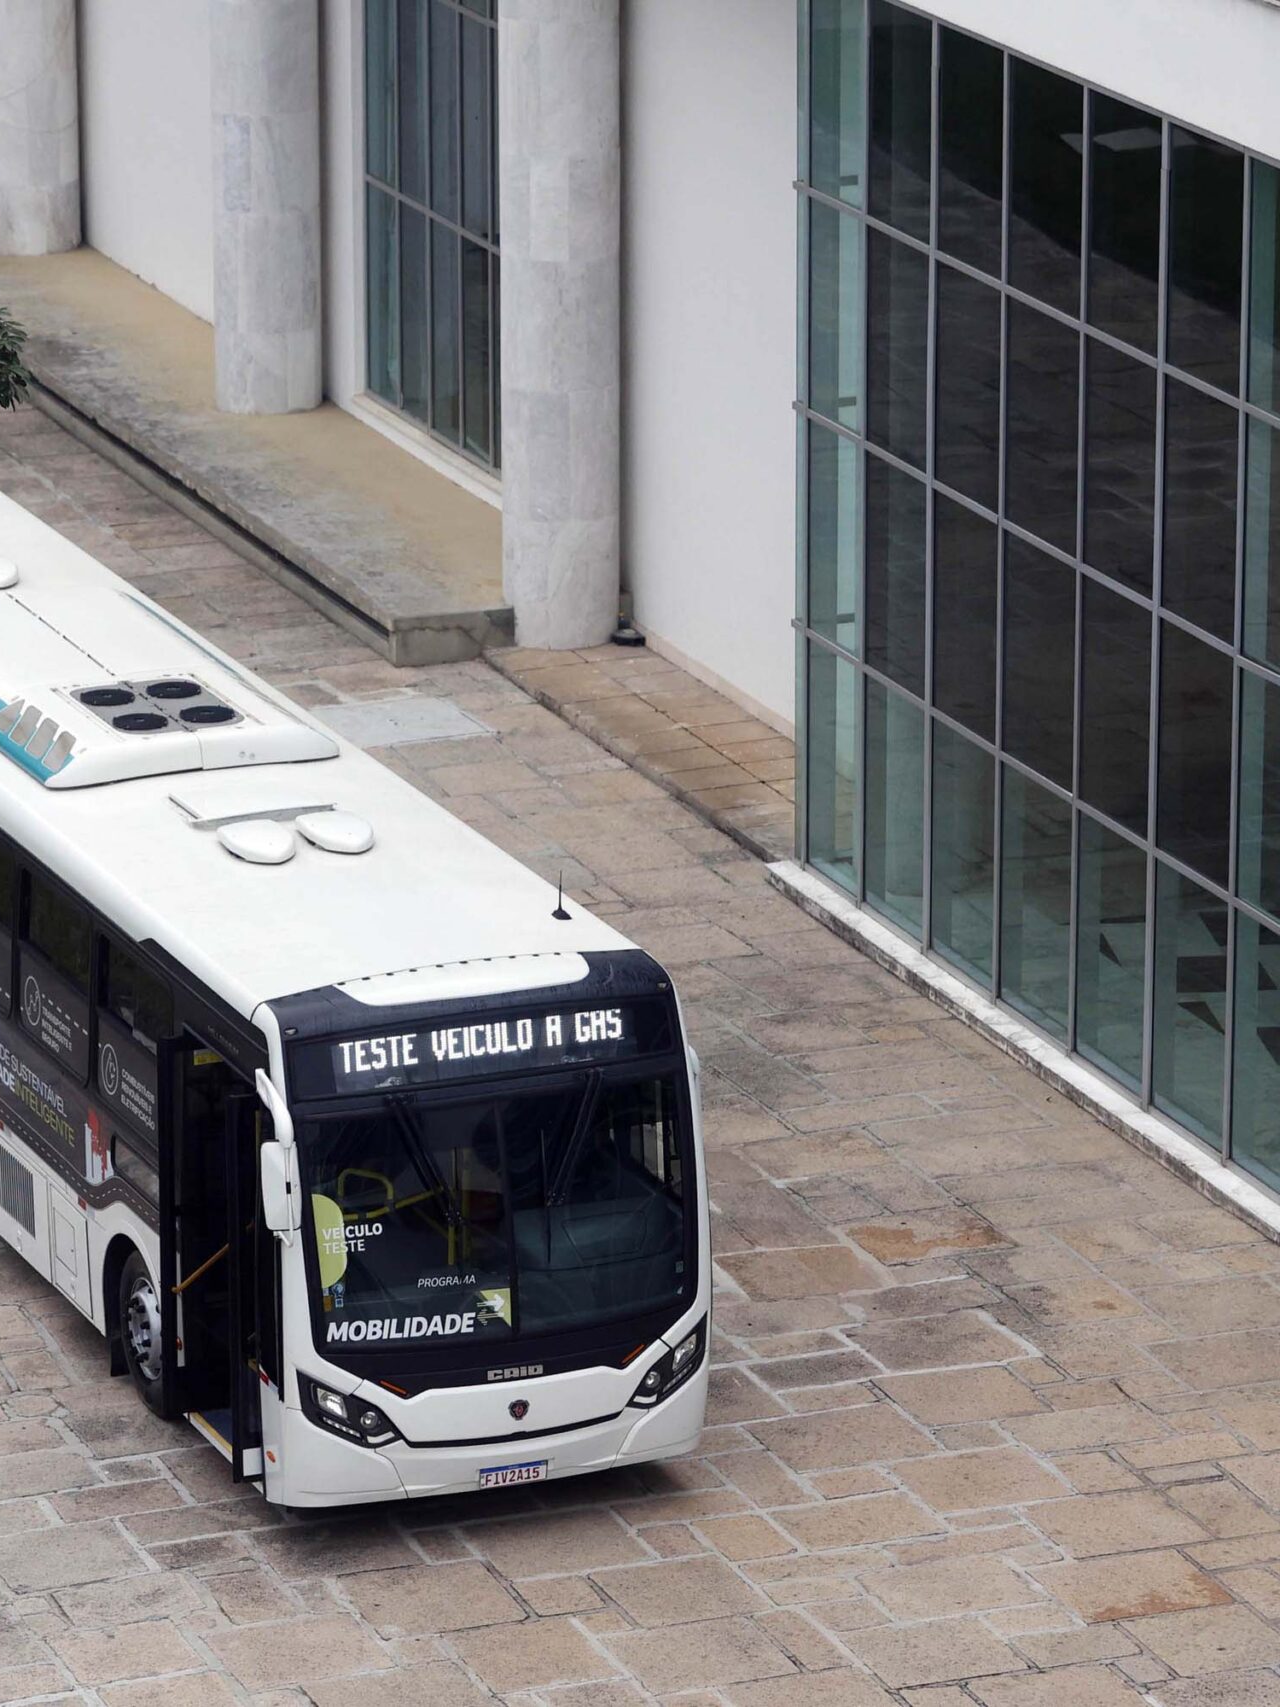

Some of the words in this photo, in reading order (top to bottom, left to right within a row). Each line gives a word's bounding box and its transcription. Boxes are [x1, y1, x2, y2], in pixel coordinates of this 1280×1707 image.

[42, 1006, 71, 1038] TRANSPORTE
[339, 1034, 419, 1074] TESTE
[431, 1018, 533, 1061] VEICULO
[546, 1014, 562, 1047] A
[575, 1008, 625, 1043] GAS
[10, 1054, 68, 1118] SUSTENTÁVEL
[322, 1239, 366, 1254] TESTE
[417, 1274, 476, 1288] PROGRAMA
[326, 1312, 477, 1343] MOBILIDADE
[485, 1466, 541, 1486] FIV2A15
